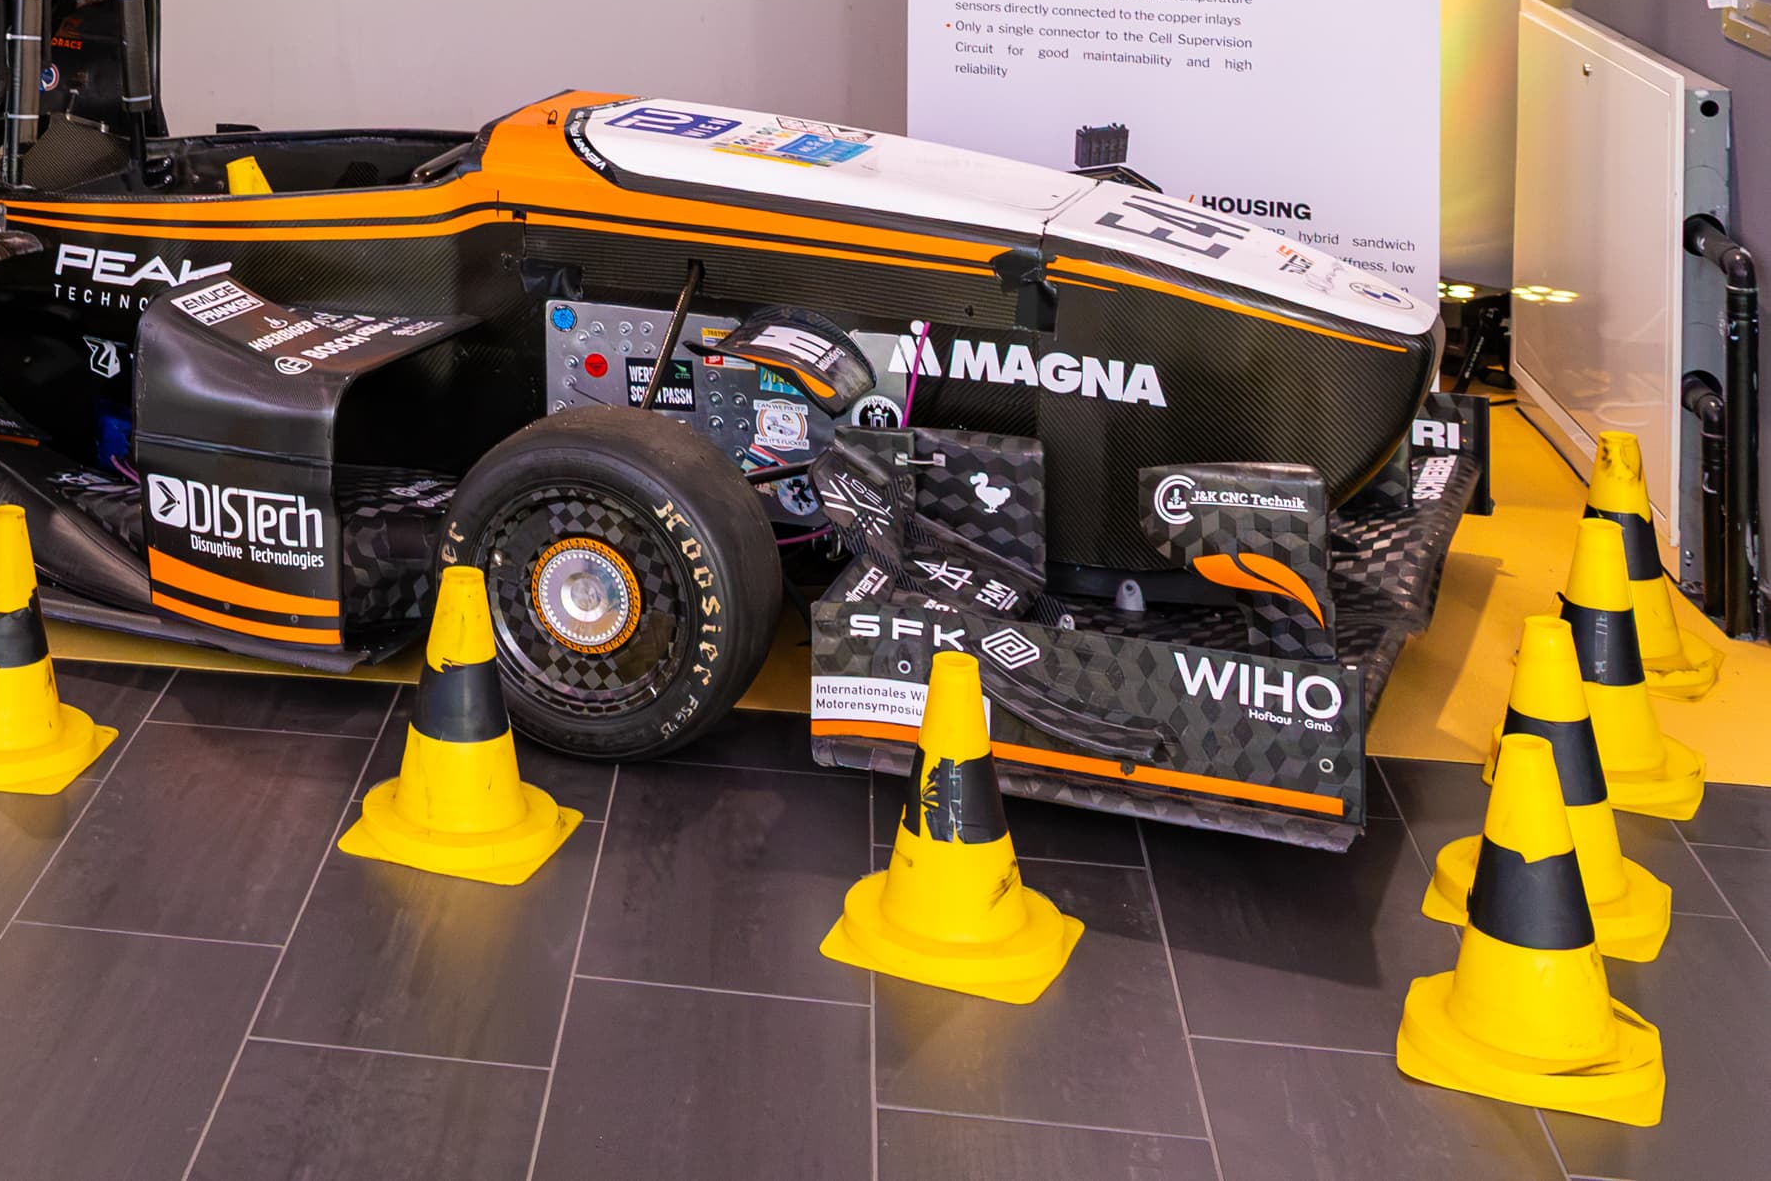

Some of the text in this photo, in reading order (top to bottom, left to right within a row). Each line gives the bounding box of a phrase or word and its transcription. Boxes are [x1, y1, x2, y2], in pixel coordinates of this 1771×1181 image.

[1201, 194, 1312, 222] HOUSING
[1298, 230, 1416, 252] hybrid sandwich
[54, 242, 233, 288] PEAK
[181, 284, 239, 314] EMUGE
[196, 295, 259, 324] FRANKEN
[247, 320, 320, 352] HOERBIGER
[300, 333, 371, 360] BOSCH
[948, 338, 1168, 408] MAGNA
[662, 386, 693, 405] PASSN
[1411, 454, 1458, 500] SCHIEBEL
[834, 472, 894, 519] TEST
[1190, 489, 1305, 510] J&K CNC Technik
[186, 479, 324, 549] DISTech
[190, 534, 325, 570] Disruptive Technologies
[652, 498, 722, 687] Hoosier
[975, 579, 1011, 609] FAM
[849, 613, 966, 652] SFK
[815, 682, 907, 700] Internationales
[1173, 650, 1343, 719] WIHO
[815, 699, 923, 717] Motorensymposiu
[1248, 707, 1292, 726] Hofbau
